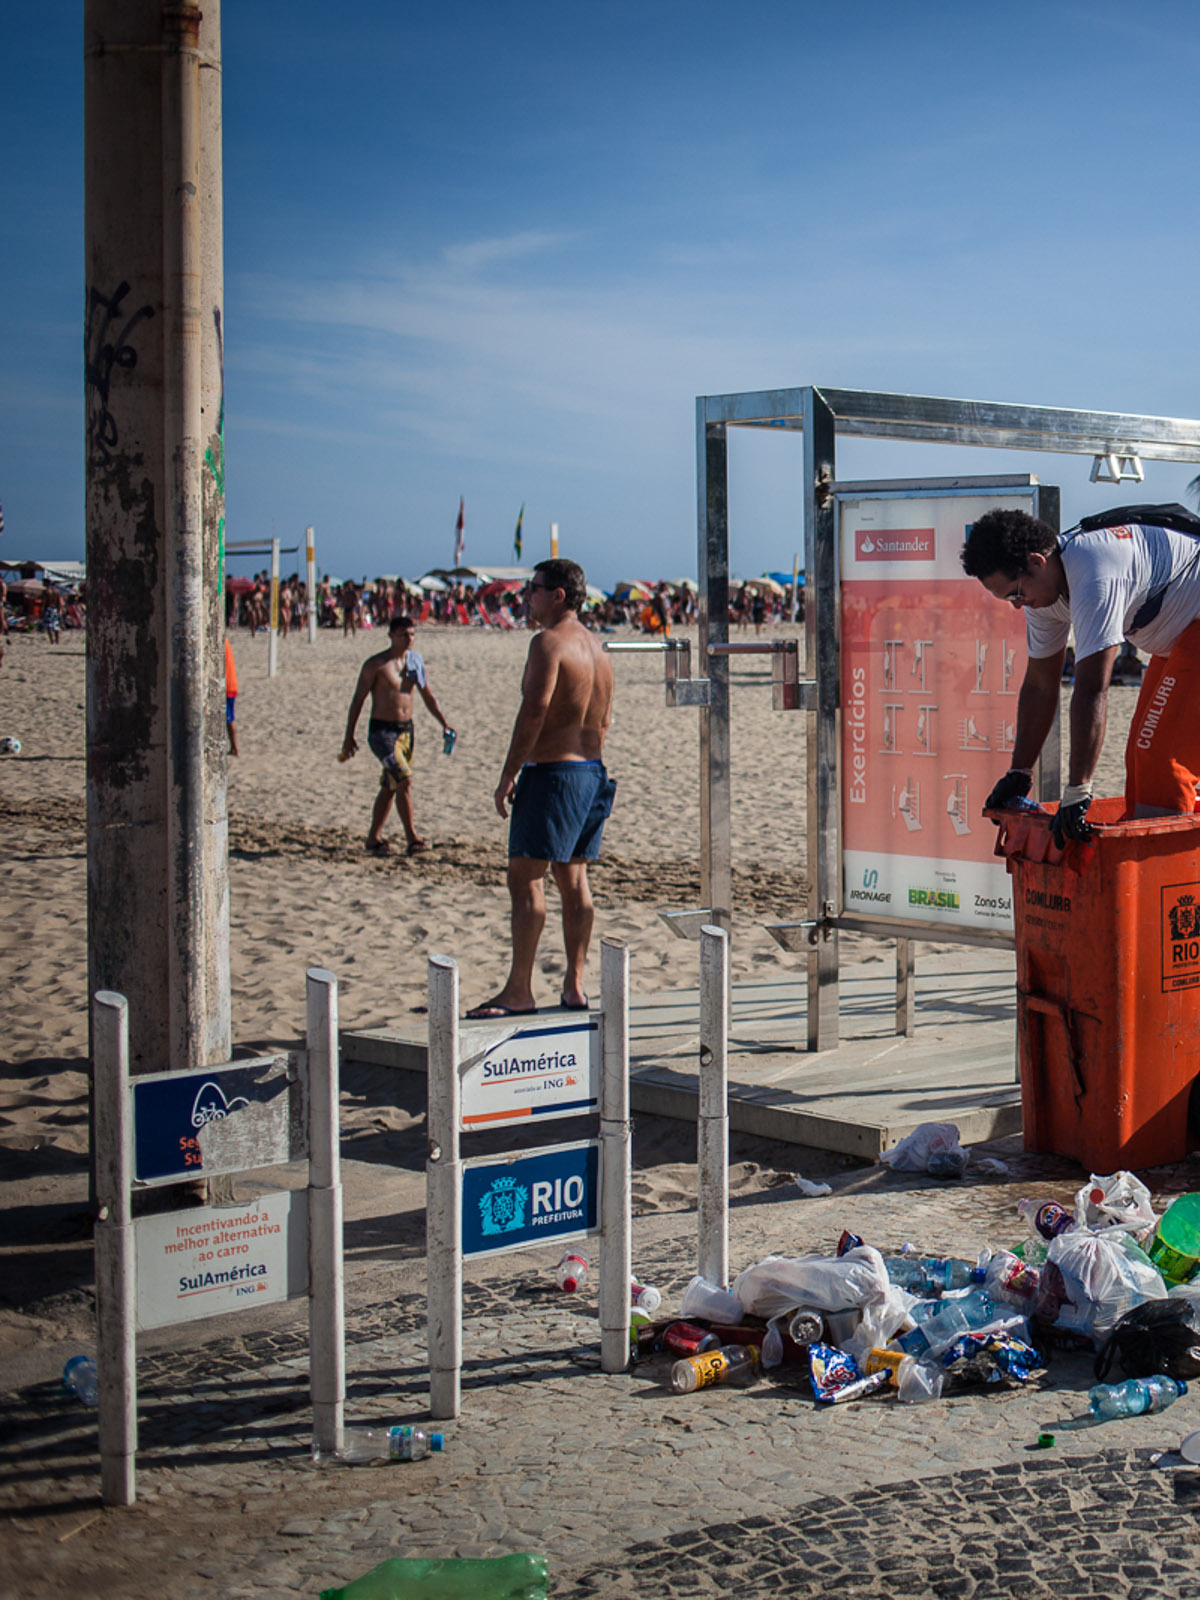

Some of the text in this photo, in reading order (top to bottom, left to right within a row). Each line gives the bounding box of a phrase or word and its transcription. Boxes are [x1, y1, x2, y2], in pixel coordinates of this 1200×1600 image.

[876, 536, 930, 552] Santander
[1137, 676, 1177, 750] COMLURB
[848, 667, 866, 803] Exercícios
[850, 889, 892, 904] IRONAGE
[908, 889, 960, 909] BRASIL
[974, 894, 1011, 910] Zona Sul
[1025, 888, 1071, 913] COMLURB
[1172, 942, 1200, 963] RIO
[1172, 976, 1200, 988] COMLURB
[483, 1051, 577, 1078] SulAmérica
[543, 1078, 564, 1090] ING
[531, 1175, 584, 1215] RIO
[176, 1212, 269, 1238] Incentivando a
[531, 1209, 584, 1227] PREFEITURA
[164, 1224, 281, 1254] melhor alternativa
[198, 1244, 249, 1262] ao carro
[179, 1263, 268, 1292] SulAmérica
[236, 1285, 255, 1296] ING
